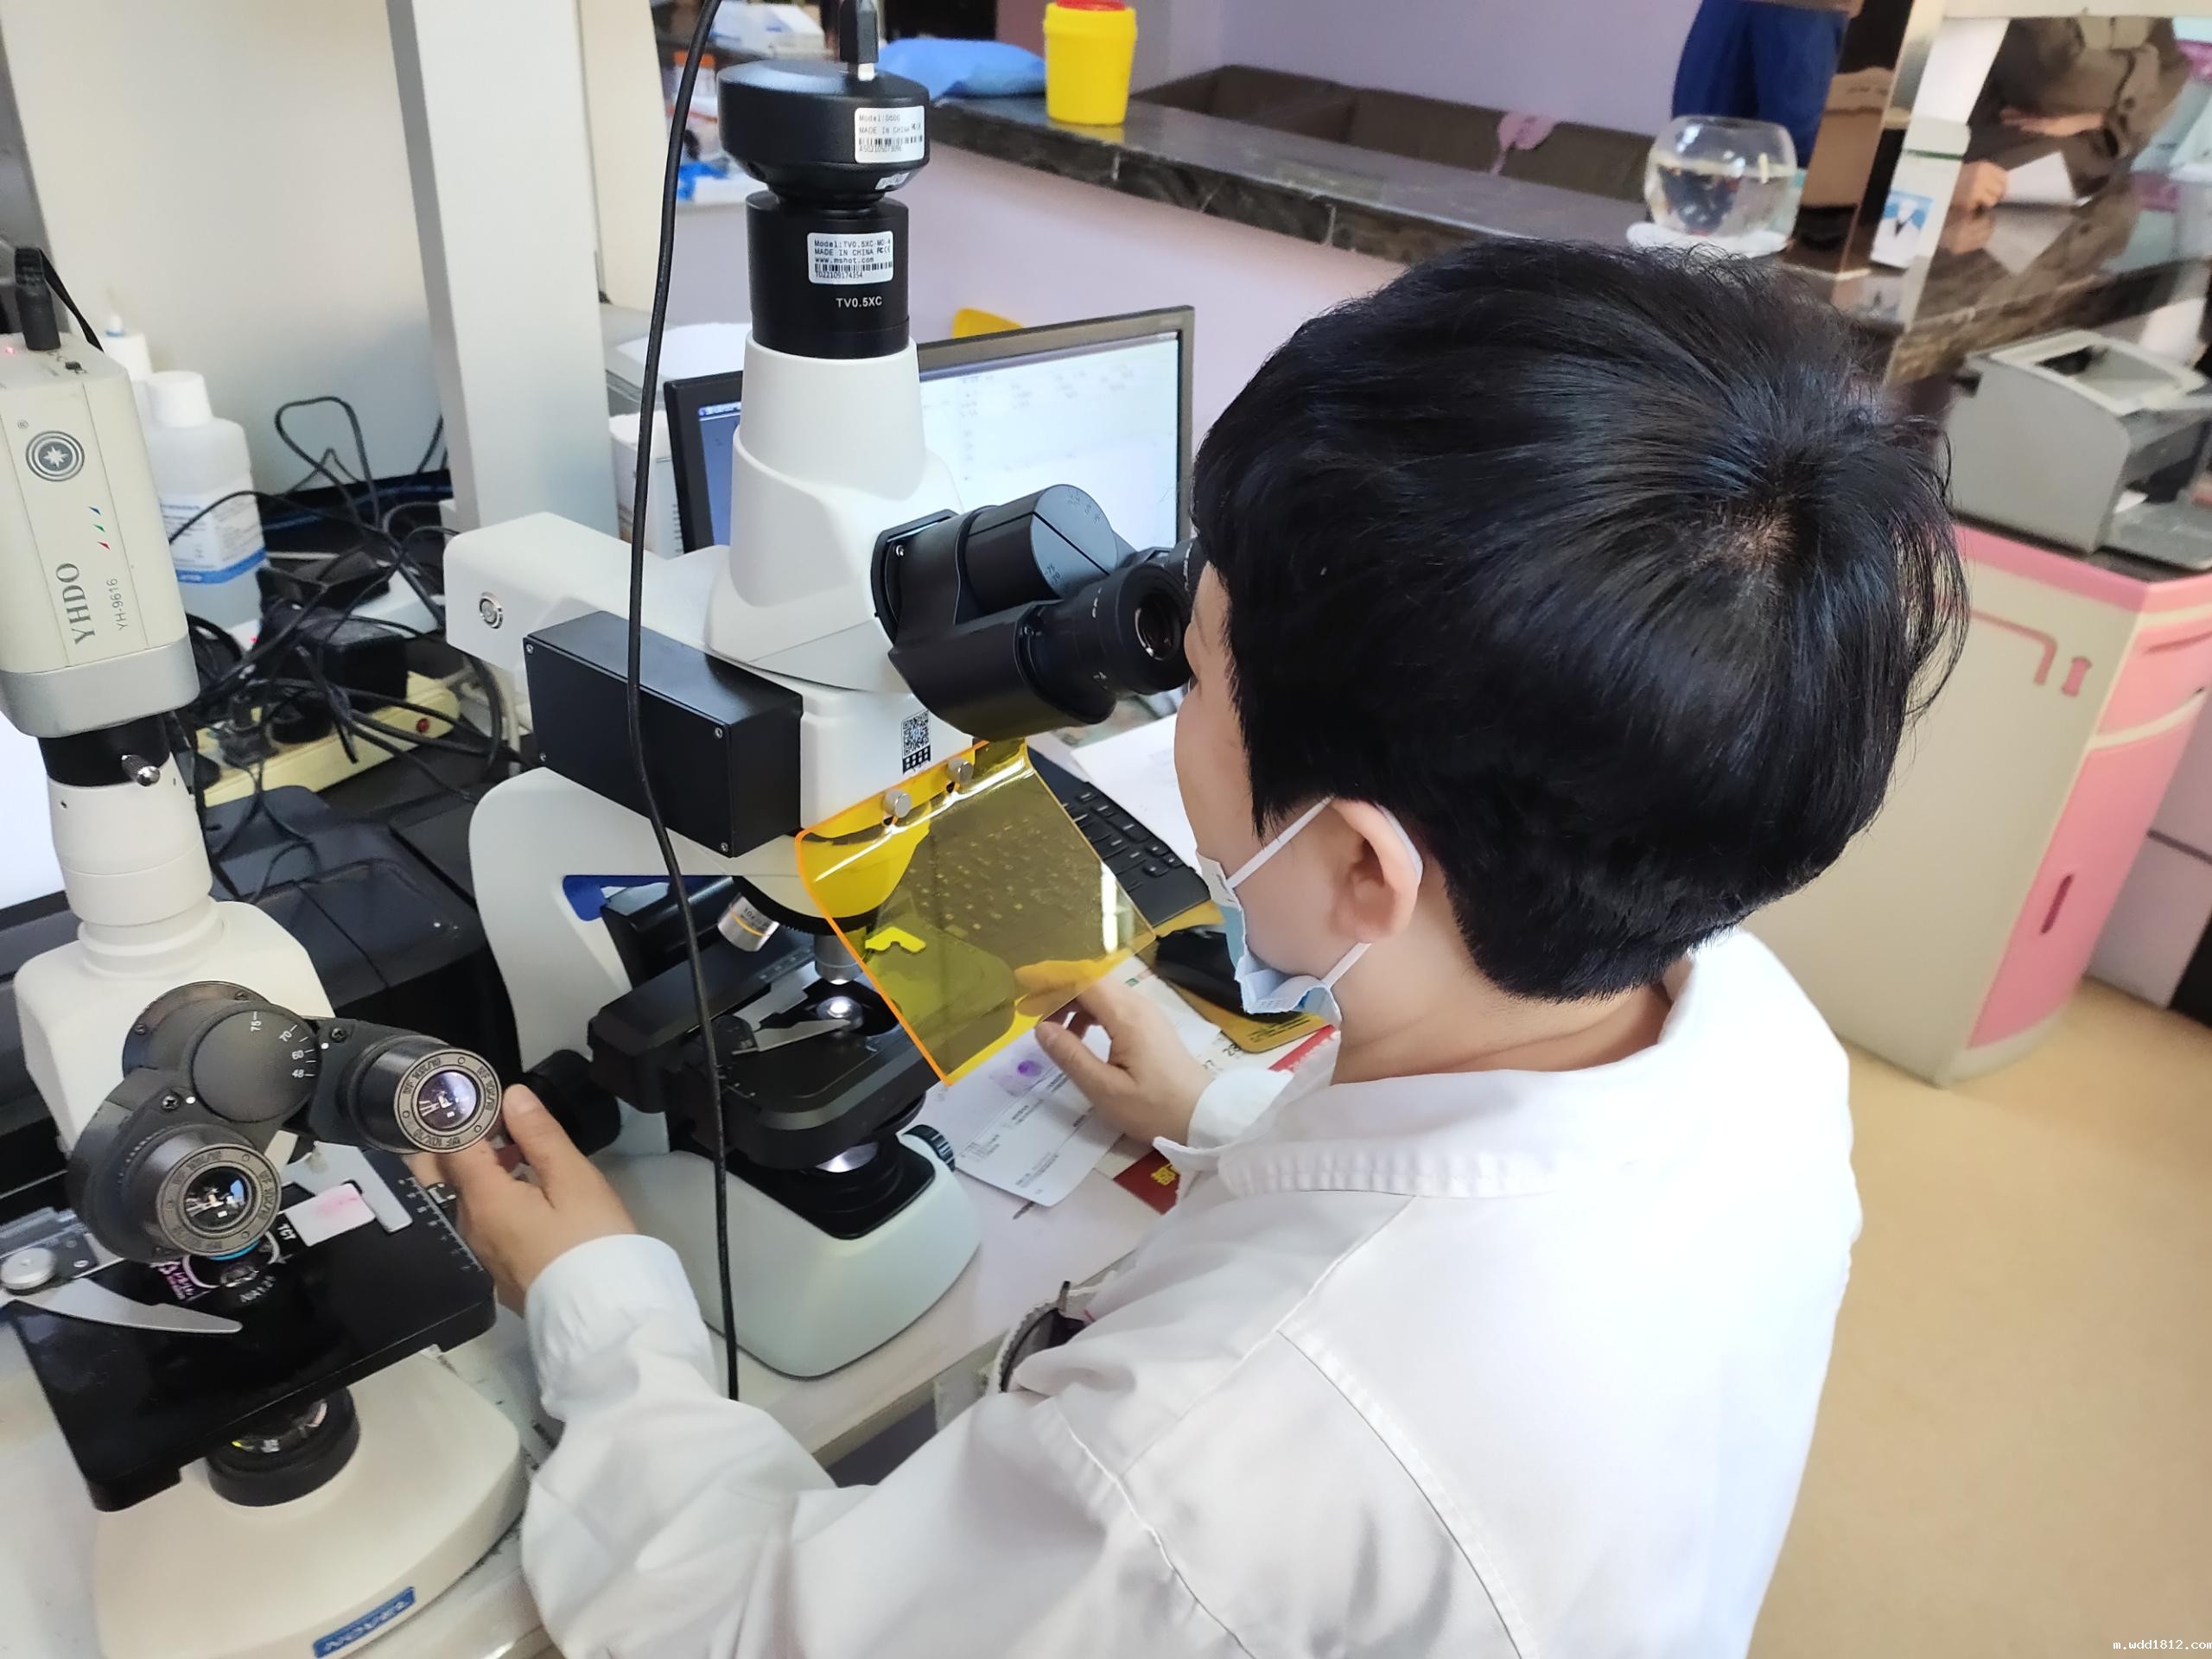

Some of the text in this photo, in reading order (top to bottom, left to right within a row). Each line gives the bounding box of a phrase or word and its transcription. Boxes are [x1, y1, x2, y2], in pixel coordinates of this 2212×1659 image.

[859, 126, 877, 135] MADE
[882, 126, 890, 135] IN
[852, 248, 874, 257] CHINA
[836, 296, 882, 308] TV0.5XC
[55, 563, 96, 645] YHDO
[105, 578, 130, 631] YH-9616
[250, 1020, 262, 1032] 75
[278, 1030, 292, 1042] 70
[291, 1050, 304, 1060] 60
[291, 1069, 304, 1078] 48
